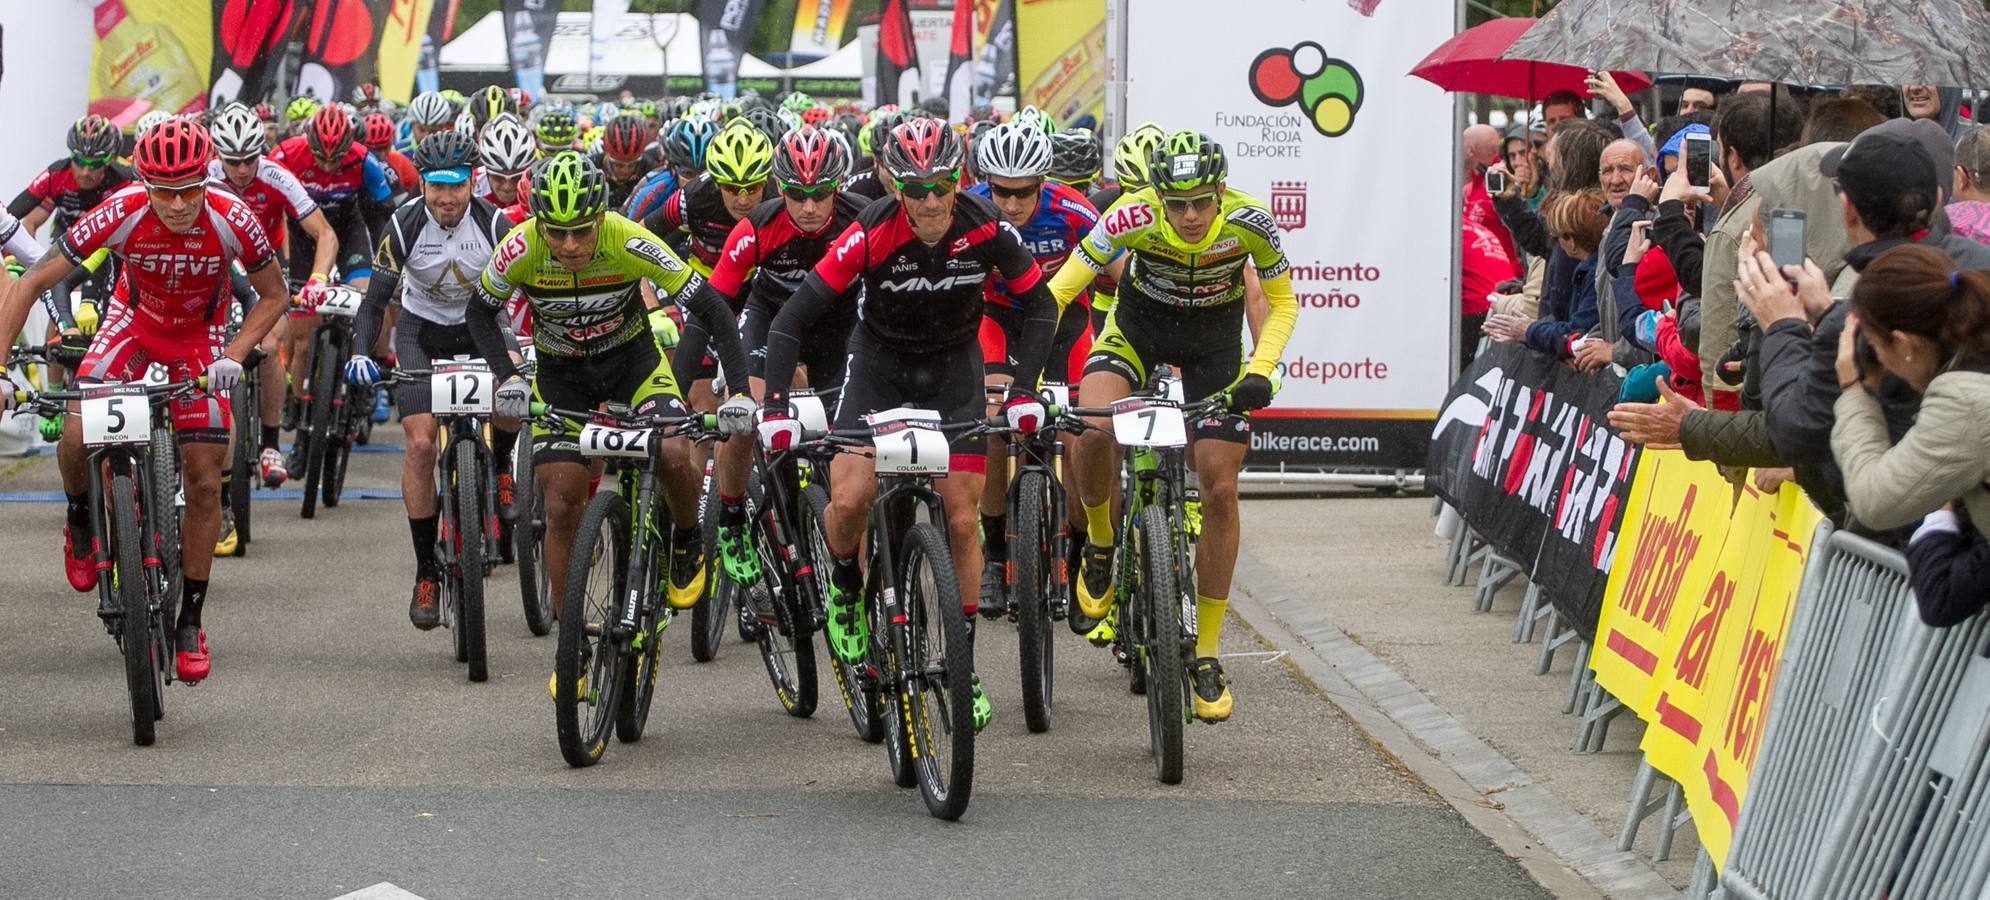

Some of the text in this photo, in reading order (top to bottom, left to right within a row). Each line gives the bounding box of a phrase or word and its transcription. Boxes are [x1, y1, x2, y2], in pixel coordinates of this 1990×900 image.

[1215, 111, 1302, 128] FUNDACIÓN
[1236, 141, 1302, 158] DEPORTE
[1261, 127, 1303, 143] RIOJA
[71, 197, 126, 248] ESTEVE
[1060, 198, 1098, 223] SHIMANO
[1104, 202, 1154, 236] GAES
[226, 202, 270, 256] ESTEVE
[494, 230, 527, 274] GAES
[1022, 238, 1067, 254] HER
[128, 253, 221, 276] ESTEVE
[1289, 260, 1381, 282] miento
[537, 279, 570, 287] MAVIC
[1294, 287, 1361, 309] roño
[567, 313, 625, 341] GAES
[1281, 355, 1389, 384] odeporte
[446, 373, 480, 405] 12
[106, 398, 126, 434] 5
[1137, 409, 1158, 441] 7
[902, 430, 919, 465] 1
[1250, 432, 1379, 451] bikerace.com
[1619, 482, 1702, 633] werBar
[627, 588, 638, 620] GALFER
[902, 691, 920, 760] MAXXIS
